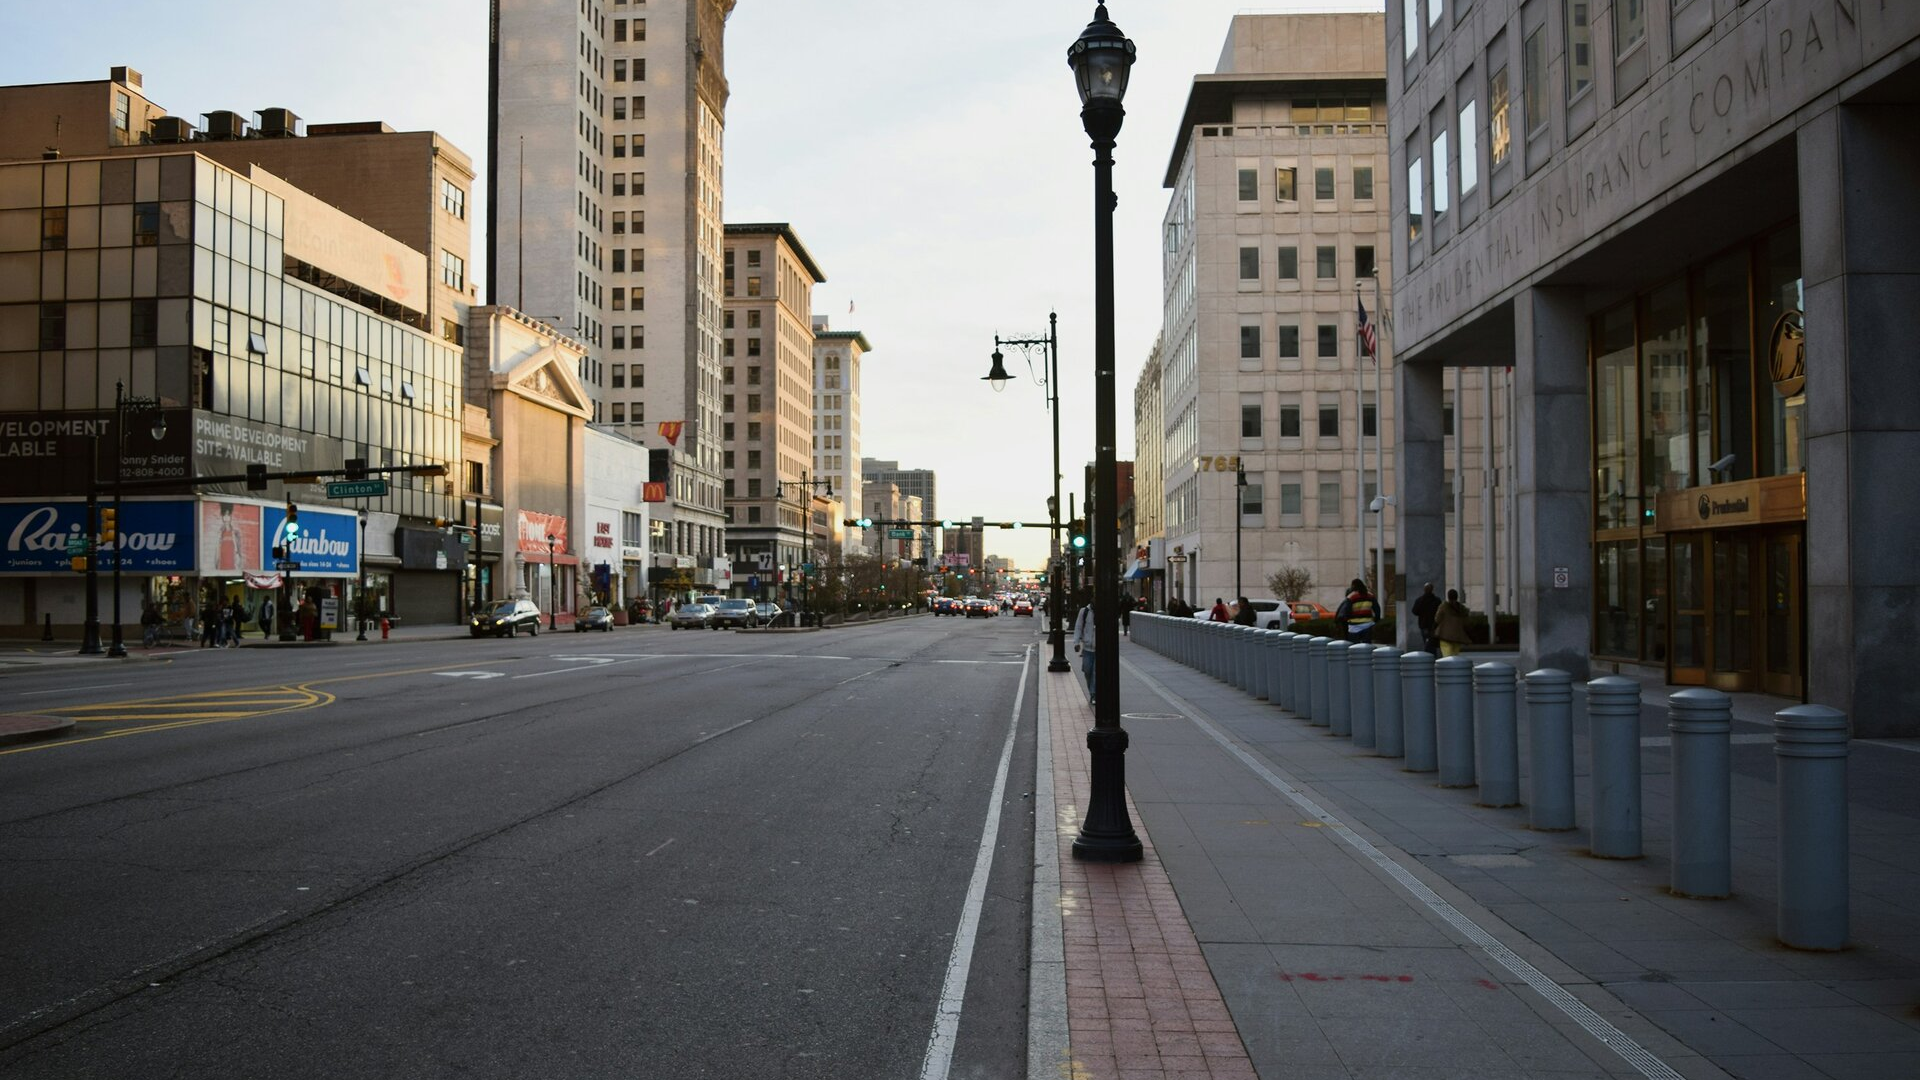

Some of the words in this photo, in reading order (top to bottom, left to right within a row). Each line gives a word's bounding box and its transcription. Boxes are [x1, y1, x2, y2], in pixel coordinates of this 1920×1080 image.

[1401, 295, 1422, 331] THE
[1428, 226, 1522, 314] PRUDENTIAL
[1531, 116, 1670, 245] INSURANCE
[1689, 0, 1887, 134] COMPAN
[196, 418, 232, 439] PRIME
[234, 426, 307, 453] DEVELOPMENT
[121, 456, 148, 466] onny
[151, 454, 185, 464] Snider
[196, 439, 222, 457] SITE
[225, 444, 282, 467] AVAILABLE
[120, 467, 185, 477] 12-808-4000
[1201, 456, 1238, 472] 765
[333, 485, 373, 495] Clinton
[1712, 497, 1749, 515] Prudential
